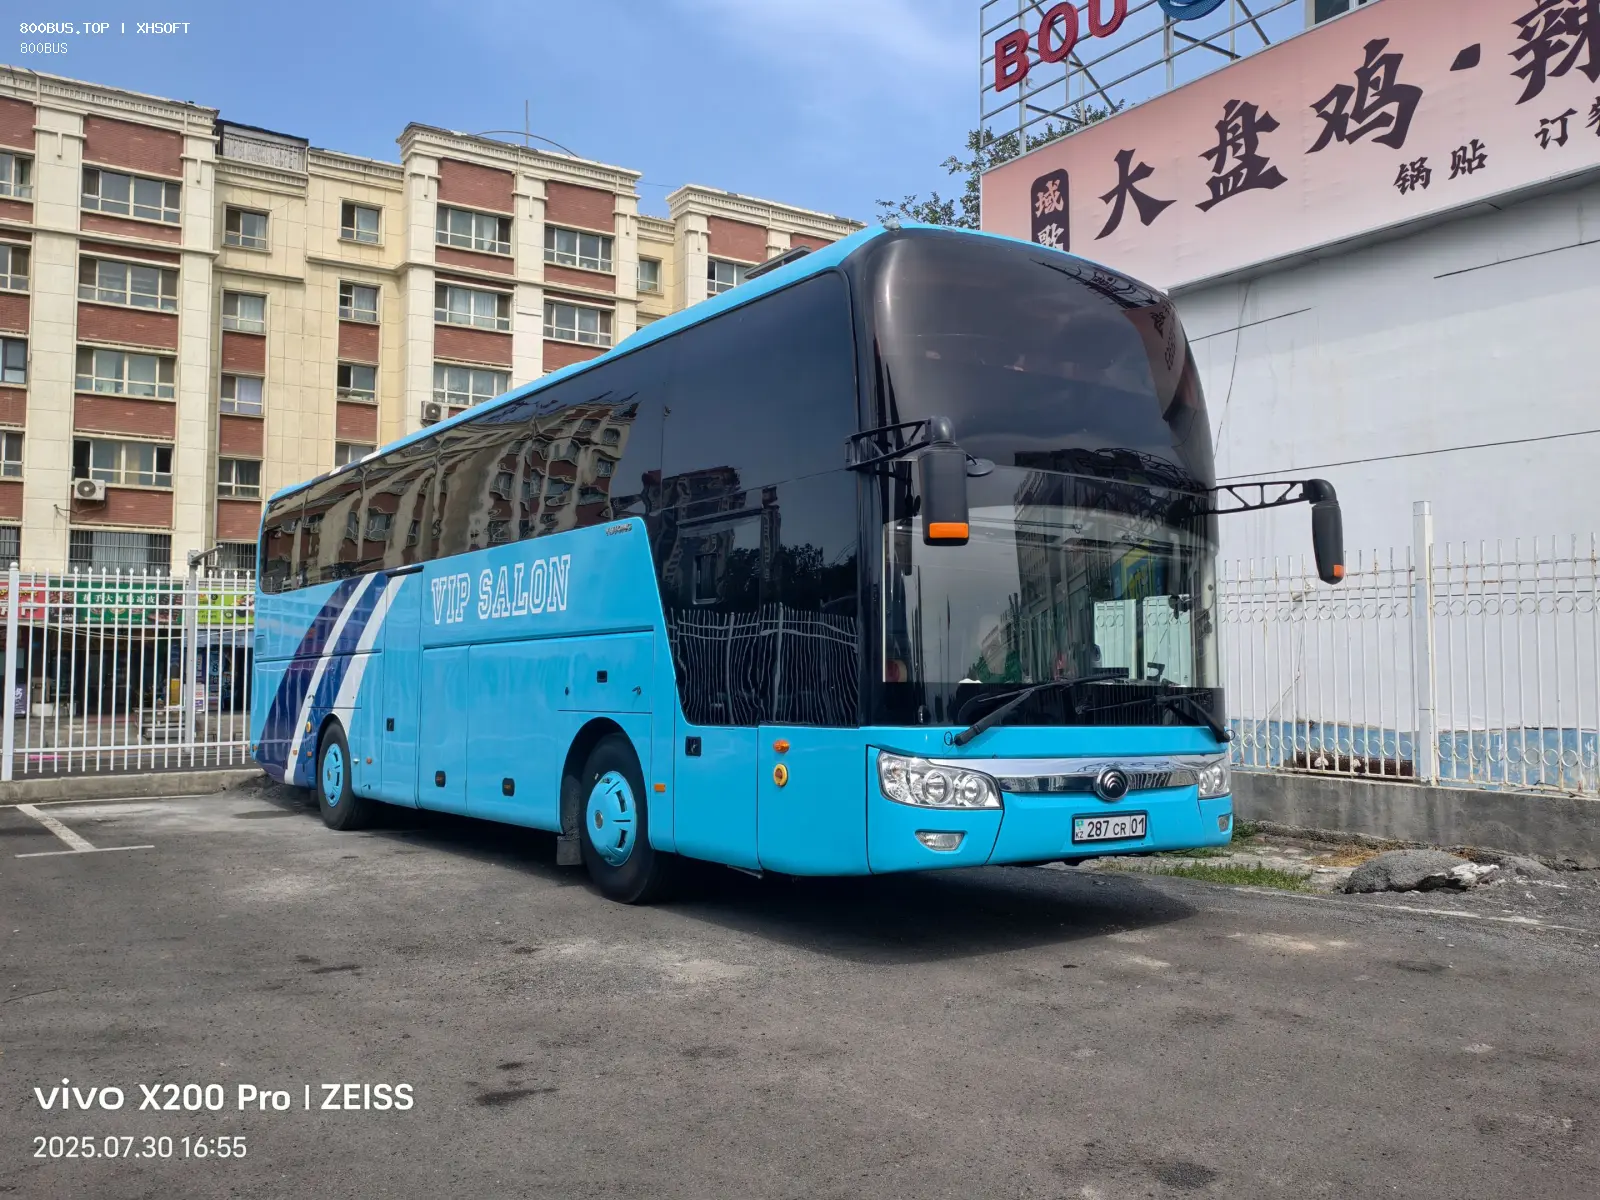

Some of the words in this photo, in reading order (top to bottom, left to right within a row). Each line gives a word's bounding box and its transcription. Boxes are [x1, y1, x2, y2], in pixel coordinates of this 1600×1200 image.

[1393, 138, 1488, 195] 锅贴
[431, 572, 471, 625] VIP
[477, 554, 571, 620] SALON
[1075, 830, 1084, 839] KZ
[1087, 820, 1110, 838] 287
[1113, 822, 1126, 836] CR
[1131, 817, 1145, 835] 01
